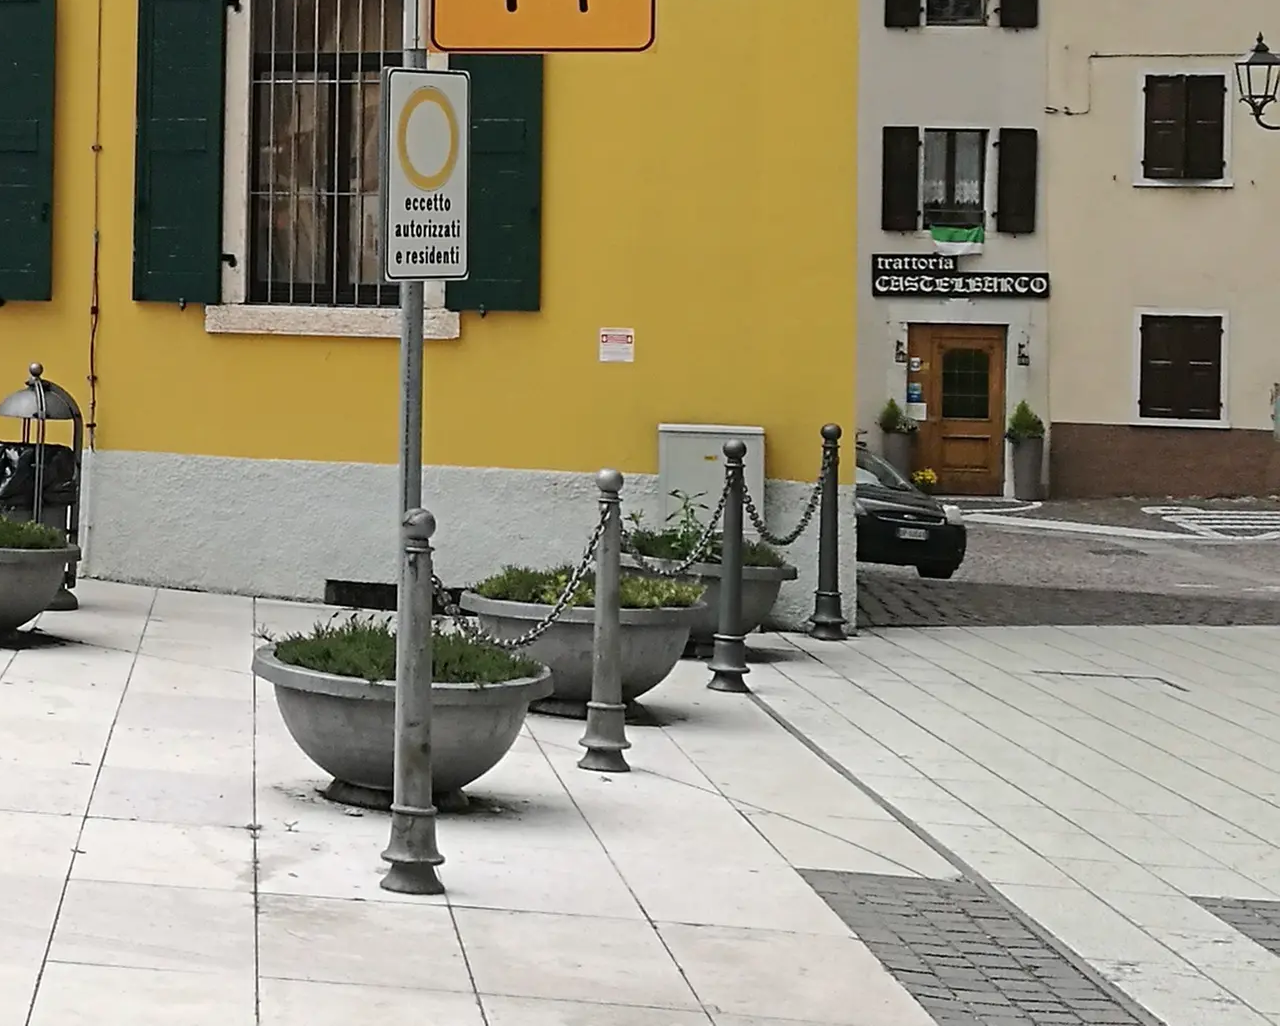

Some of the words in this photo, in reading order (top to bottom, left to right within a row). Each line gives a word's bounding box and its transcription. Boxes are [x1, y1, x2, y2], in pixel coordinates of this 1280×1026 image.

[404, 193, 452, 212] eccetto
[394, 219, 461, 239] autorizzati
[395, 248, 403, 264] e
[405, 245, 460, 265] residenti
[877, 256, 955, 270] trattoria
[874, 275, 1048, 294] CASTELBARCO
